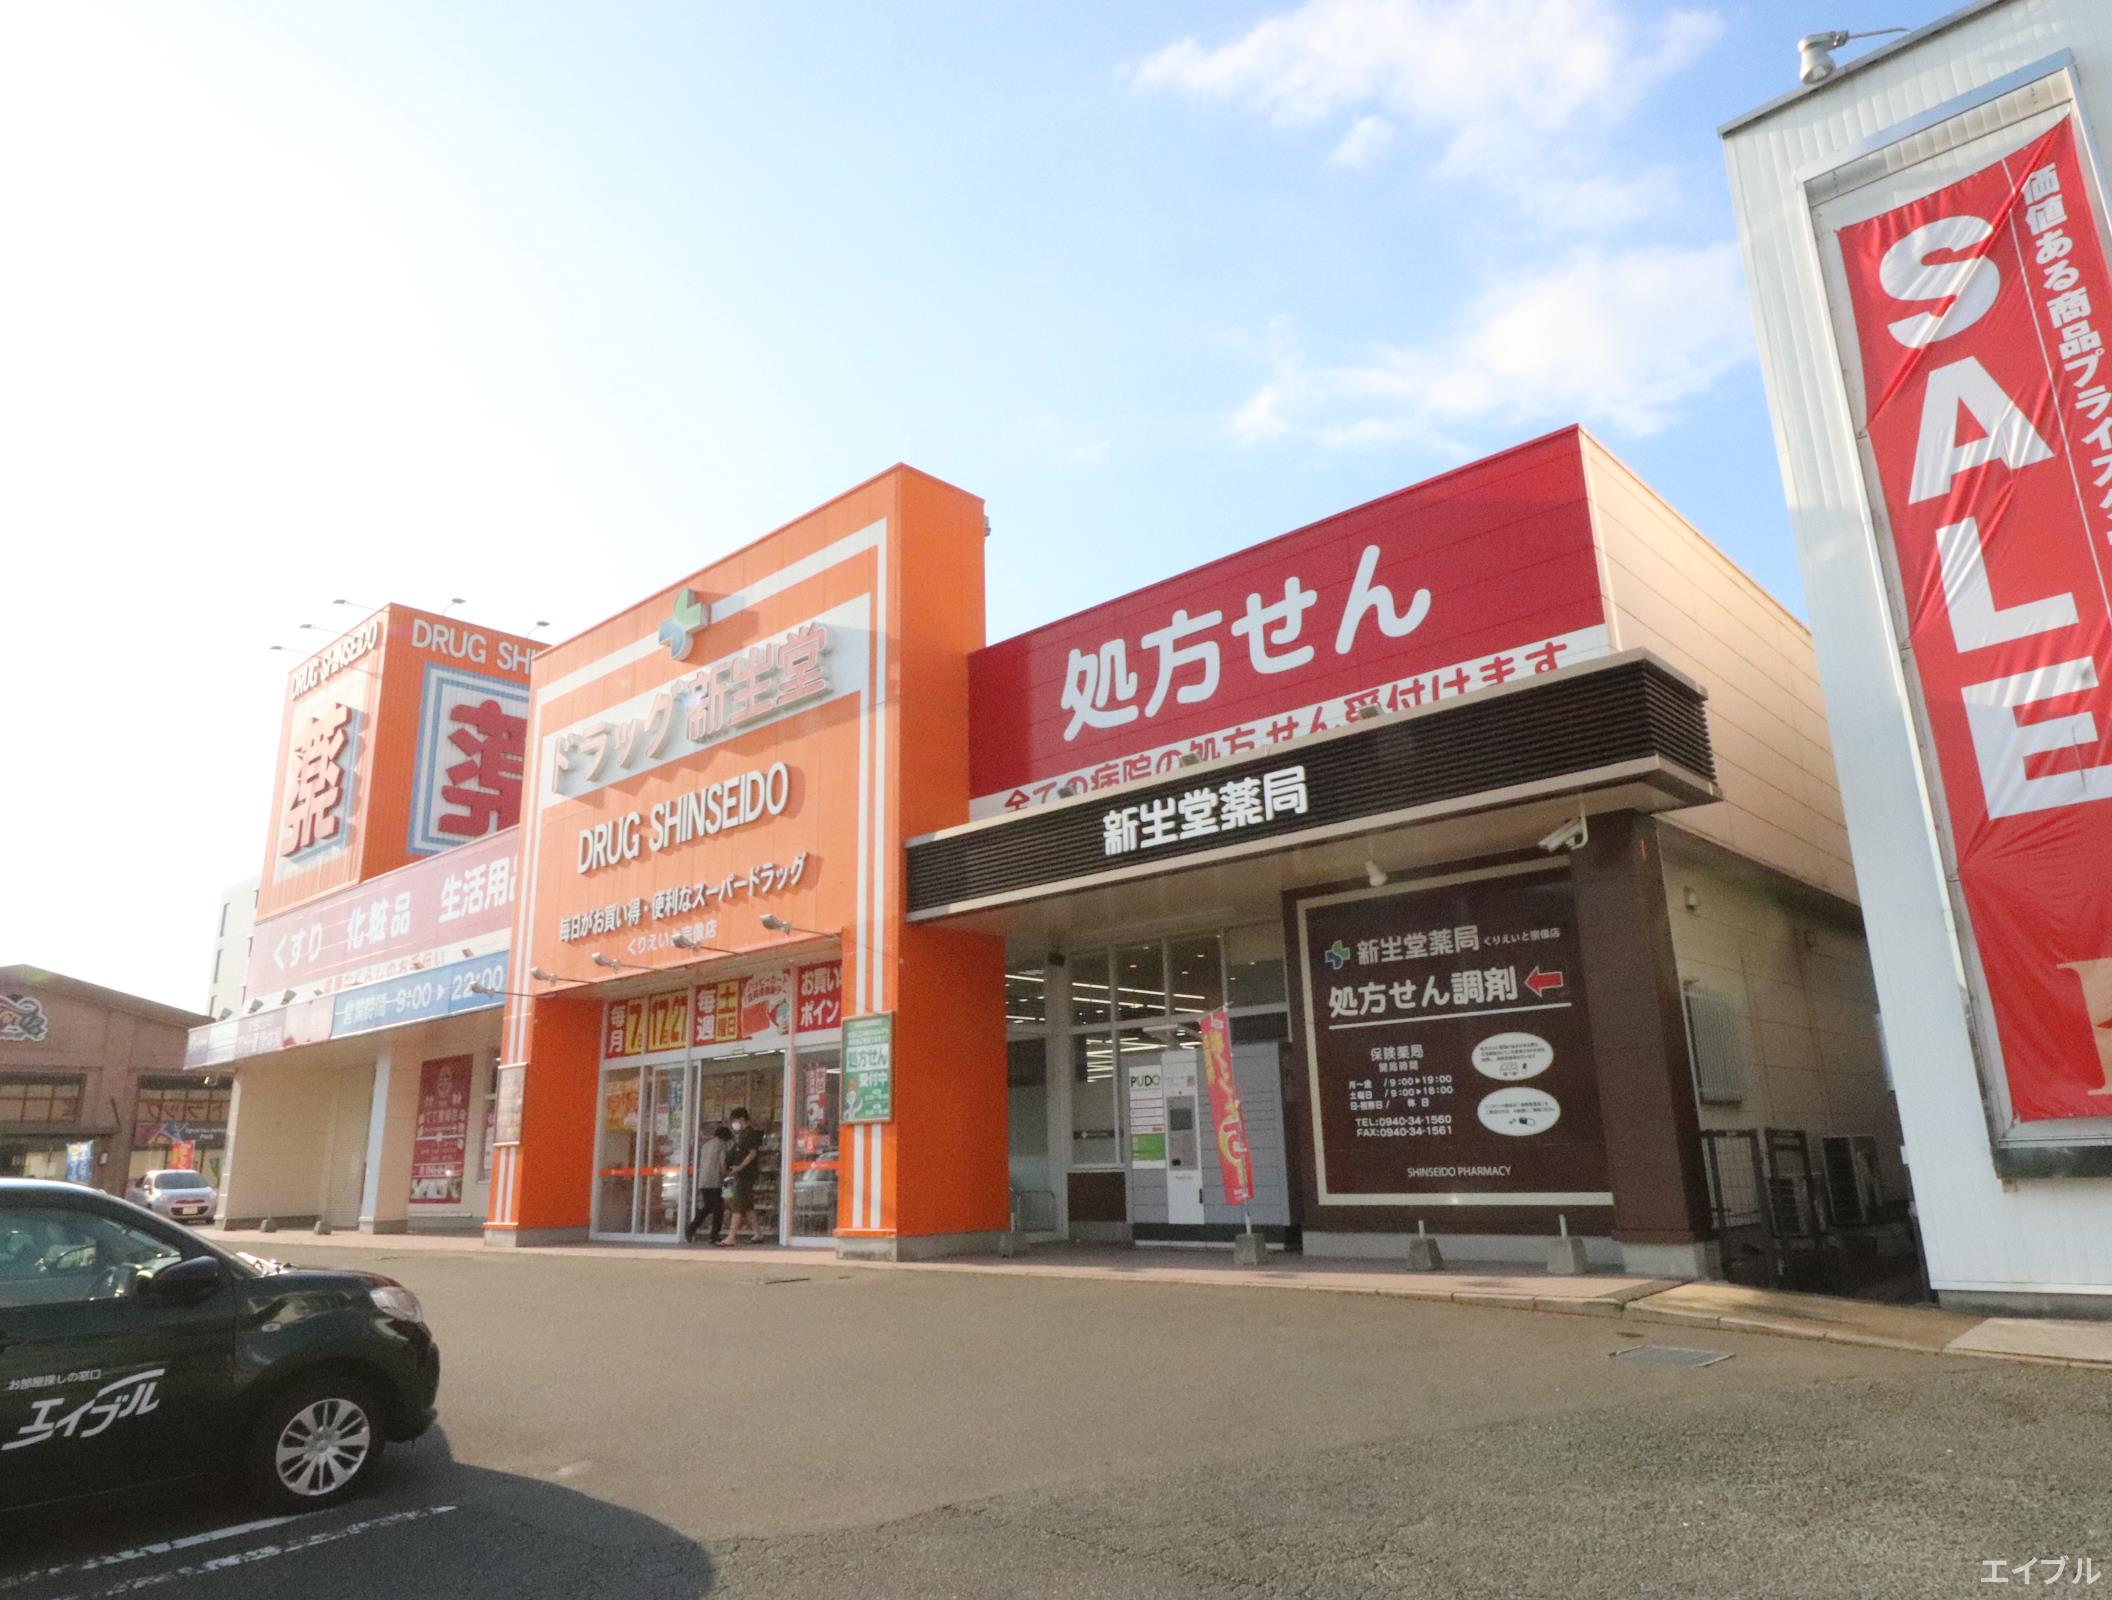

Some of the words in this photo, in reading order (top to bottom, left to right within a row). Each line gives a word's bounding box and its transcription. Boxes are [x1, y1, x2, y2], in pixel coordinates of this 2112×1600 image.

[1879, 215, 2112, 820] SALE
[411, 618, 487, 664] DRUG
[1061, 545, 1432, 741] 処方せん
[577, 812, 641, 875] DRUG
[648, 762, 789, 853] SHINSEIDO
[1103, 765, 1309, 857] 新生堂薬局
[273, 922, 324, 971] くすり
[347, 891, 411, 951] 化粧品
[439, 856, 516, 924] 生活用
[559, 851, 809, 943] 毎日がお買い得・便利なスーパードラッグ
[1356, 924, 1480, 966] 新生堂薬局
[395, 981, 433, 1013] 9:00
[451, 964, 505, 1002] 22:00
[1328, 965, 1519, 1019] 処方せん調剤
[608, 1005, 626, 1055] 毎月
[697, 989, 716, 1042] 毎週
[1130, 1074, 1161, 1088] PUDO
[1422, 1075, 1453, 1085] 19:00
[1407, 1166, 1457, 1178] SHINSEIDO
[1457, 1165, 1512, 1177] PHARMACY
[8, 1368, 102, 1391] お部屋探しの窓口
[14, 1378, 162, 1439] エイブル
